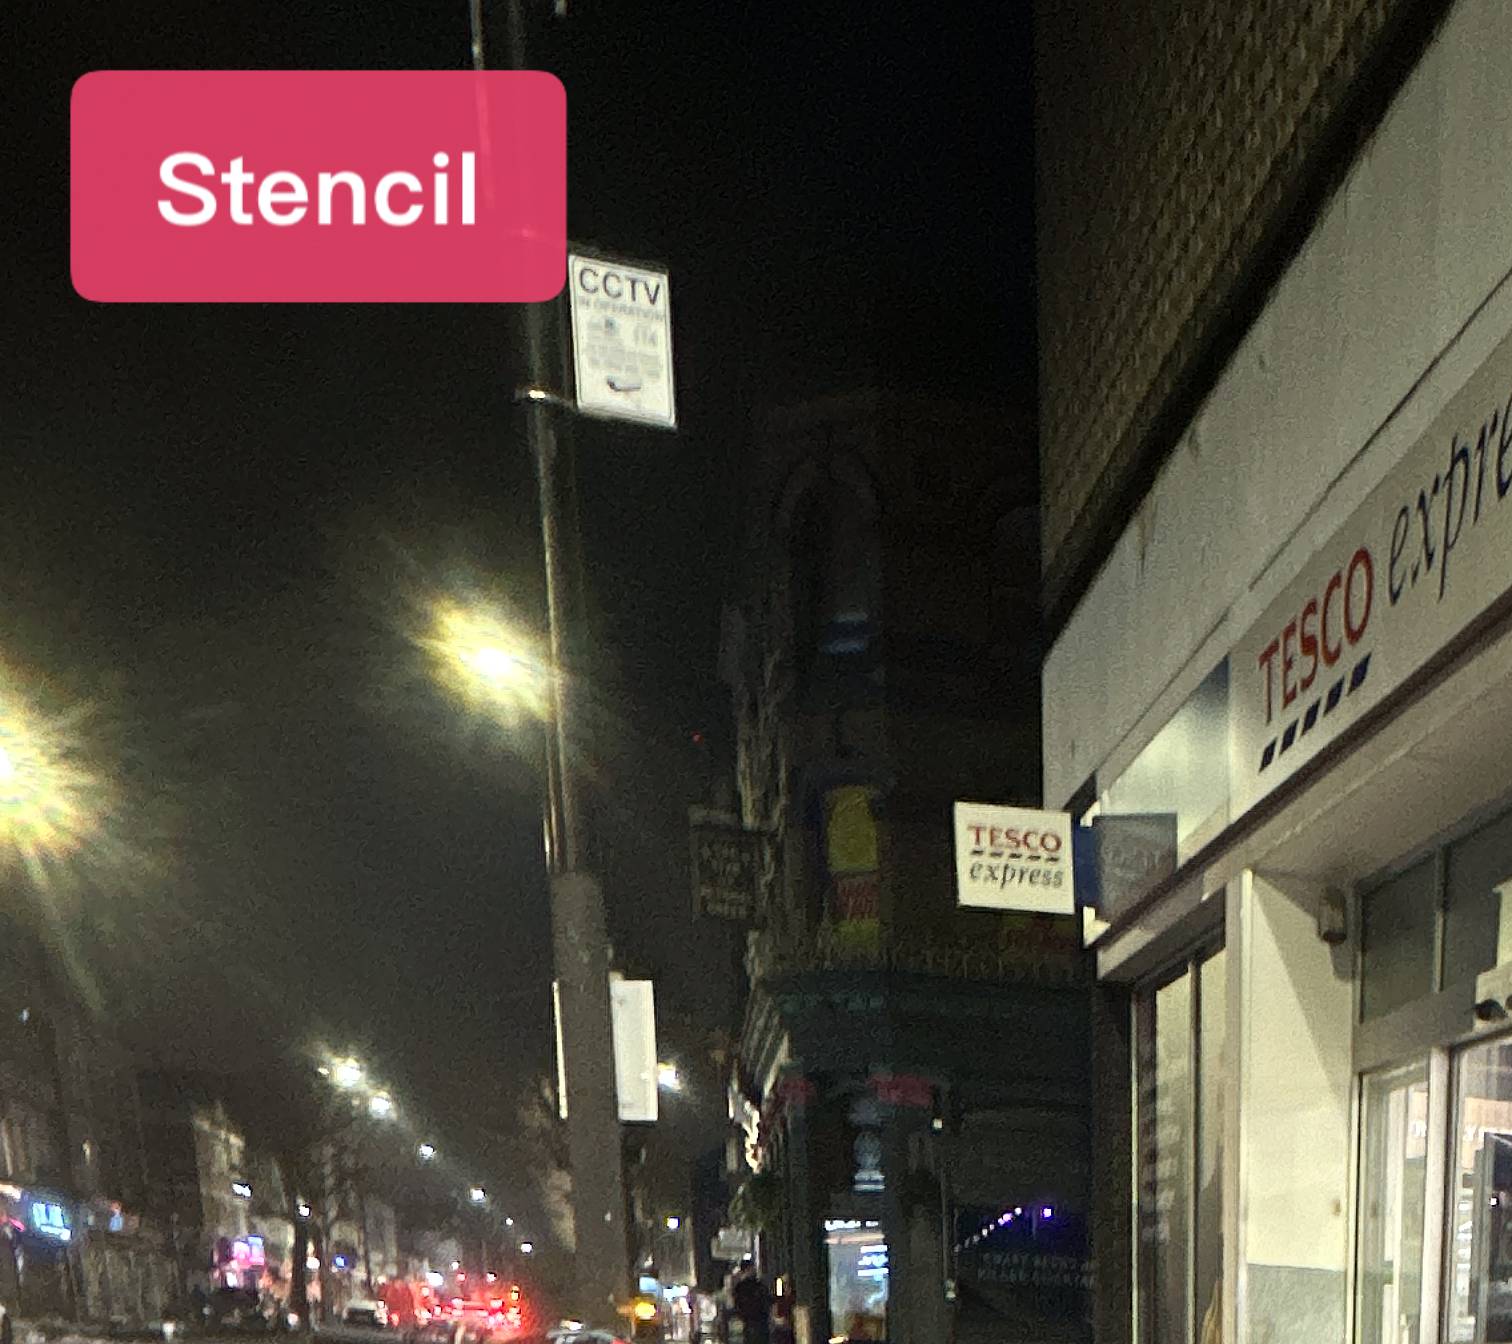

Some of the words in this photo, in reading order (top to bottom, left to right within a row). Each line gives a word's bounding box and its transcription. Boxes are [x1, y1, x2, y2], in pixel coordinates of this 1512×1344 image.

[579, 267, 660, 306] CCTV
[1258, 547, 1374, 726] TESCO
[966, 822, 1063, 854] TESCO
[968, 858, 1064, 892] express
